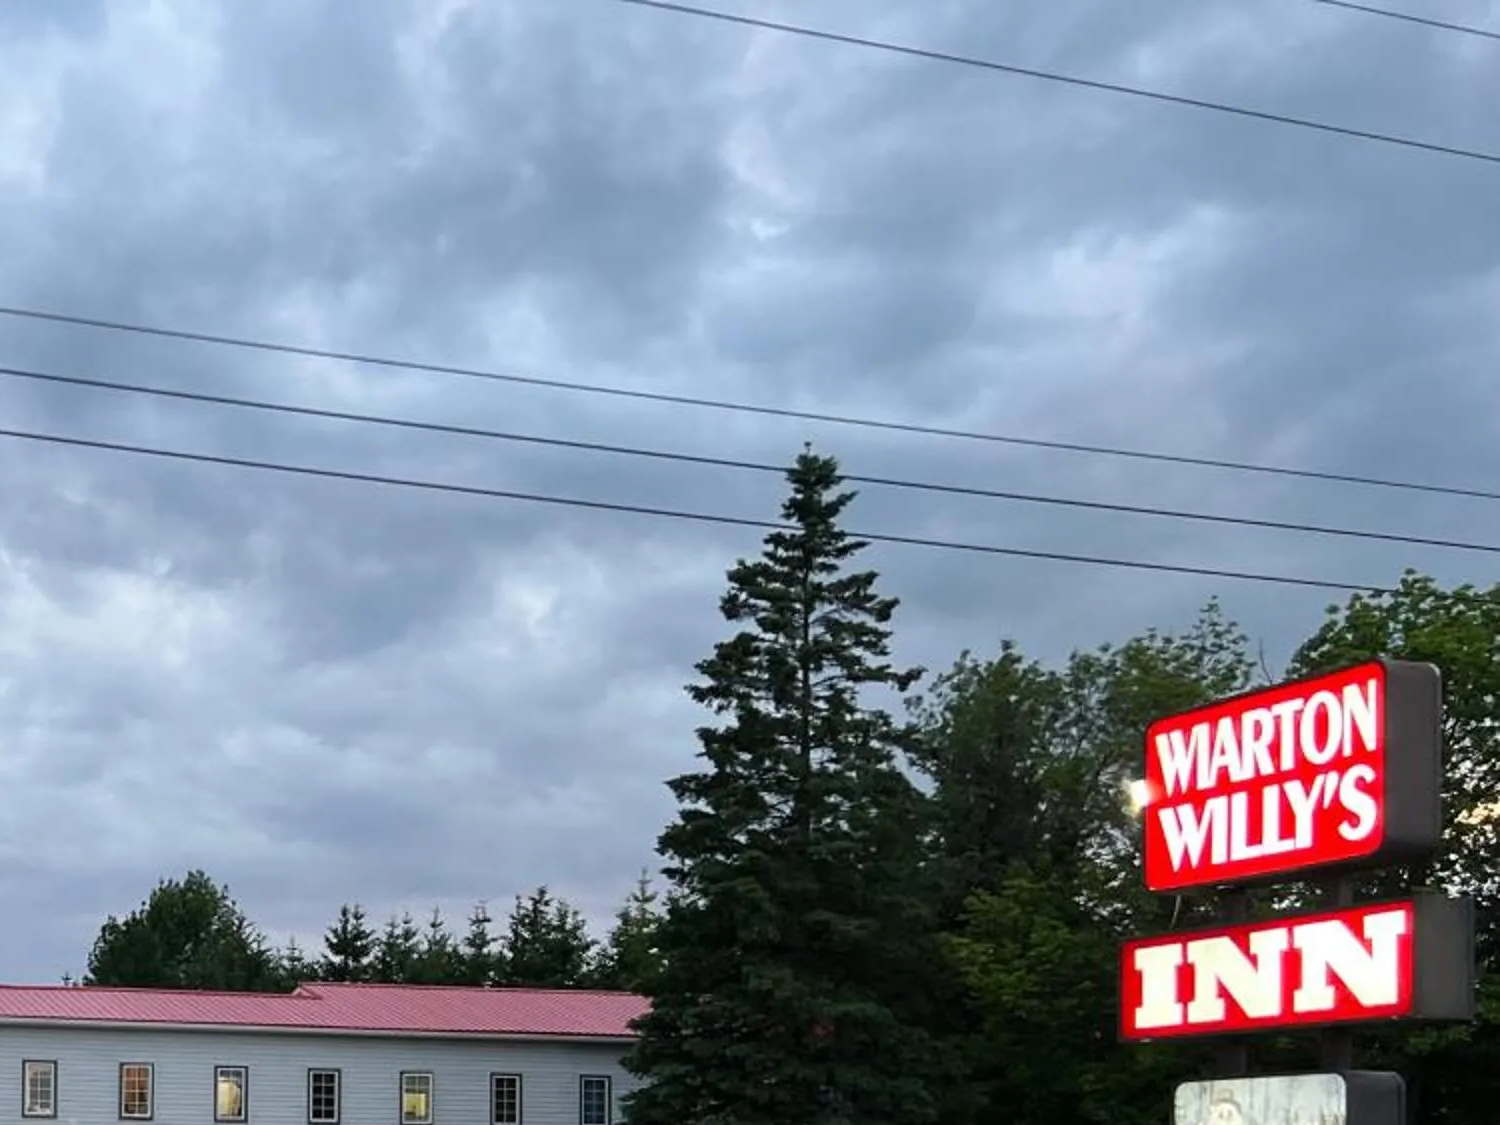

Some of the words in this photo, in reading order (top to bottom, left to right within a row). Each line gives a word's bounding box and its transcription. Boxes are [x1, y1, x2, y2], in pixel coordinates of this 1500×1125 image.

[1155, 678, 1378, 798] WIARTON
[1157, 763, 1378, 873] WILLY'S
[1134, 909, 1407, 1030] INN
